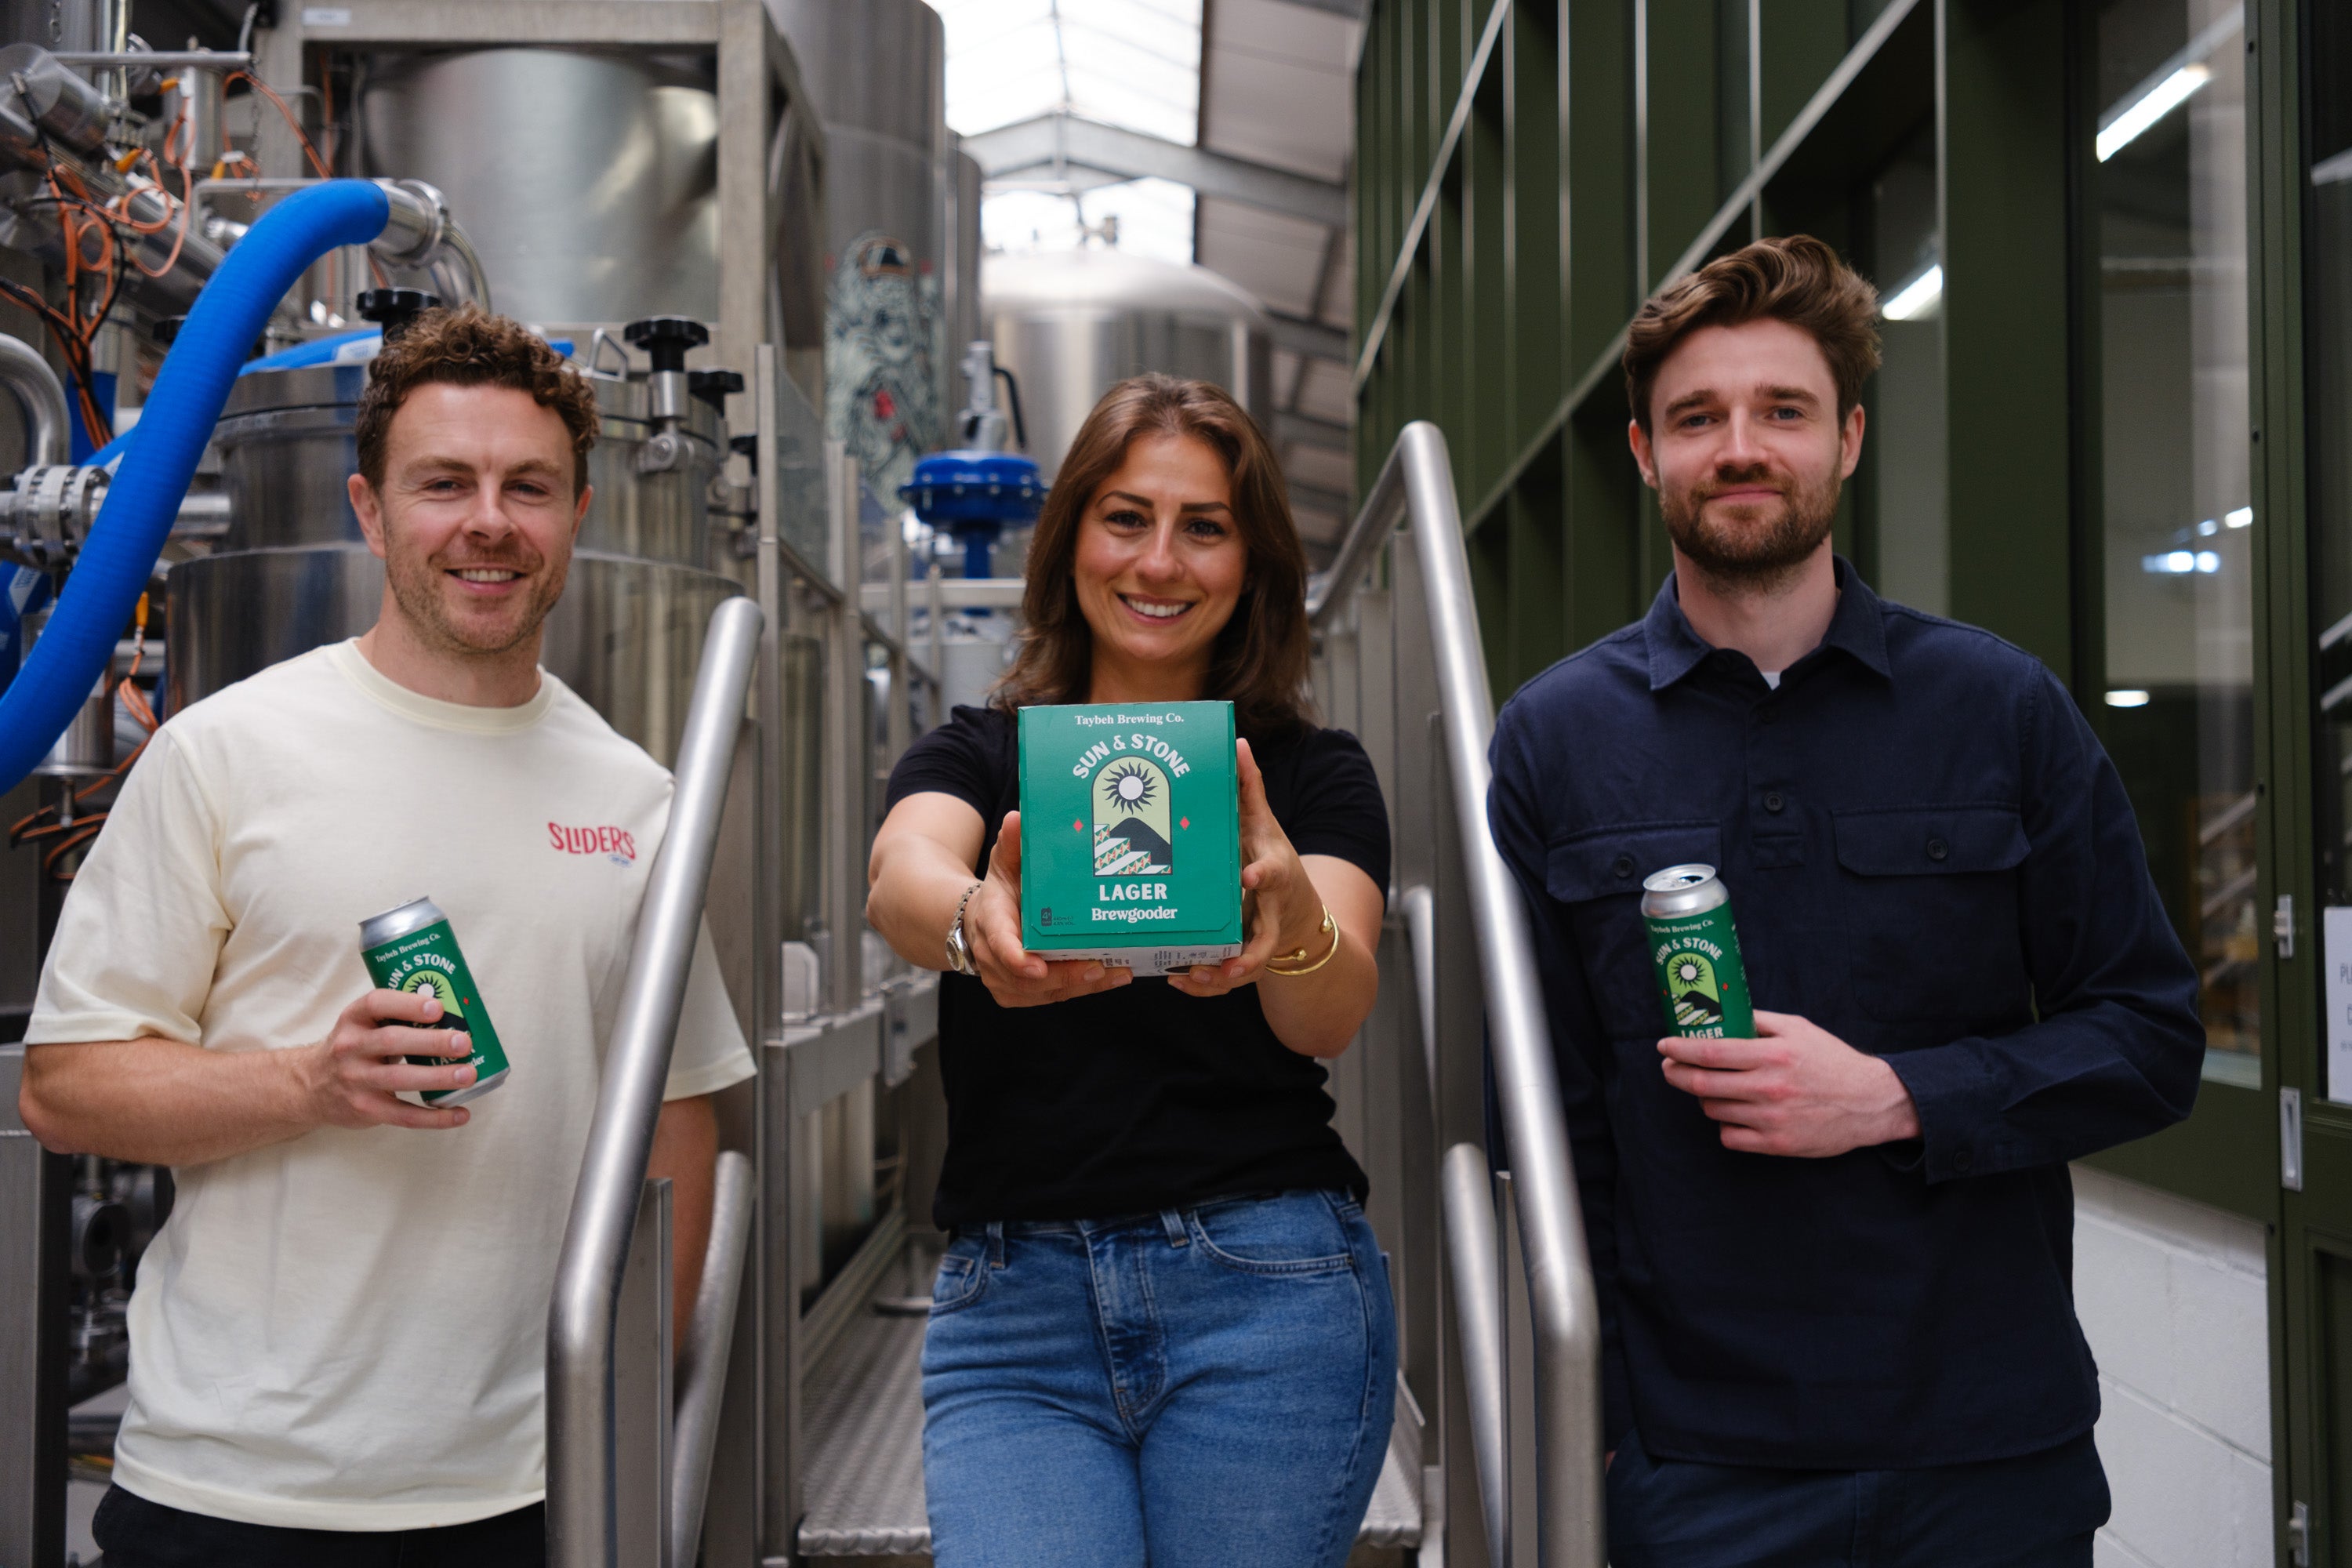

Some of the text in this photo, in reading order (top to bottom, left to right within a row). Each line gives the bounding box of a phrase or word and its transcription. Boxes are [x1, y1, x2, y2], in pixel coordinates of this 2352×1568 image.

[1075, 713, 1185, 727] Taybeh Brewing Co.
[1073, 733, 1191, 779] SUN & STONE
[548, 822, 636, 860] SLIDERS
[1099, 883, 1167, 901] LAGER
[1091, 906, 1178, 924] Brewgooder
[1671, 923, 1702, 933] Brewing
[375, 949, 399, 963] Taybeh
[398, 938, 430, 954] Brewing
[1656, 937, 1723, 965] SUN & STONE
[388, 953, 456, 990] UN & STONE
